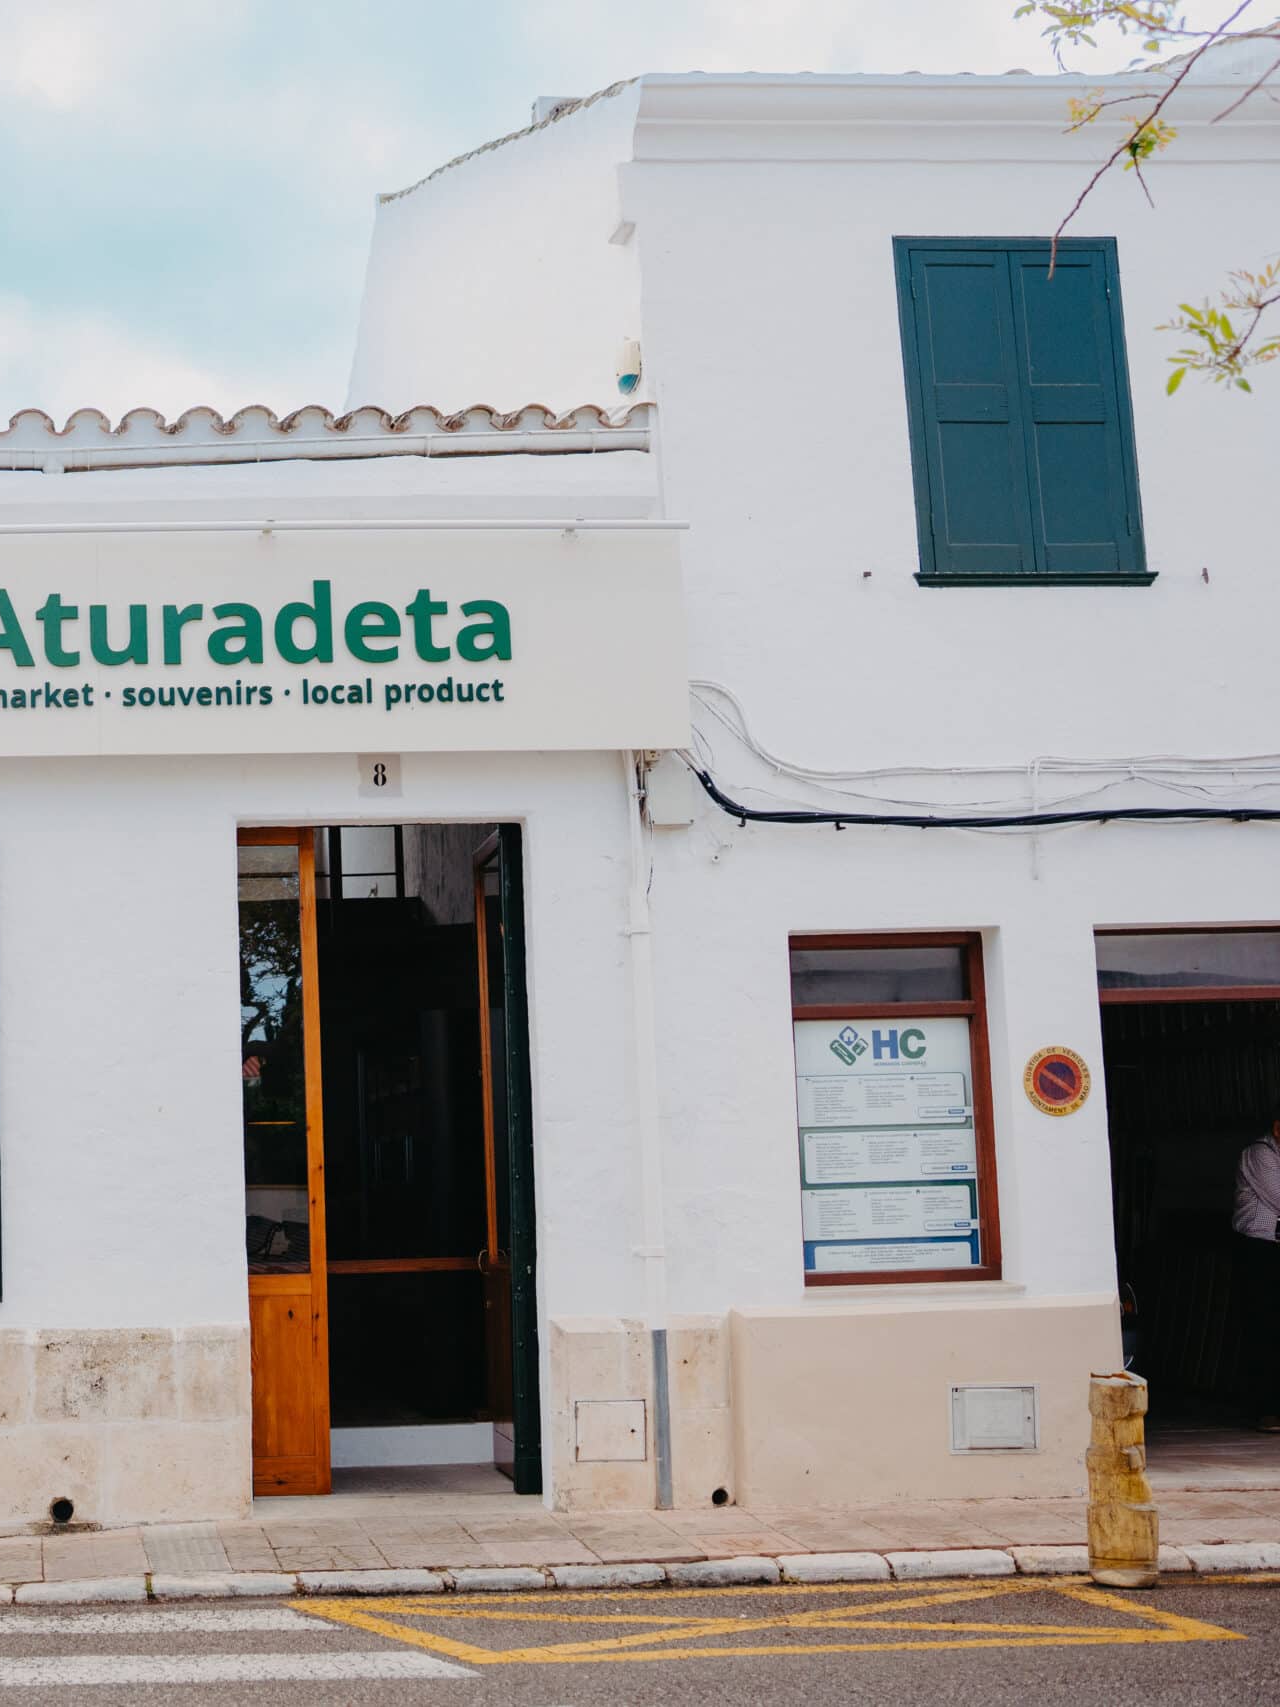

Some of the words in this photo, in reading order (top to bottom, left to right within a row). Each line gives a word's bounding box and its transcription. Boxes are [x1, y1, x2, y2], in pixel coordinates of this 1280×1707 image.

[122, 680, 274, 708] souvenirs
[301, 678, 373, 706] local
[384, 677, 505, 711] product
[372, 763, 388, 787] 8
[871, 1029, 927, 1060] HC
